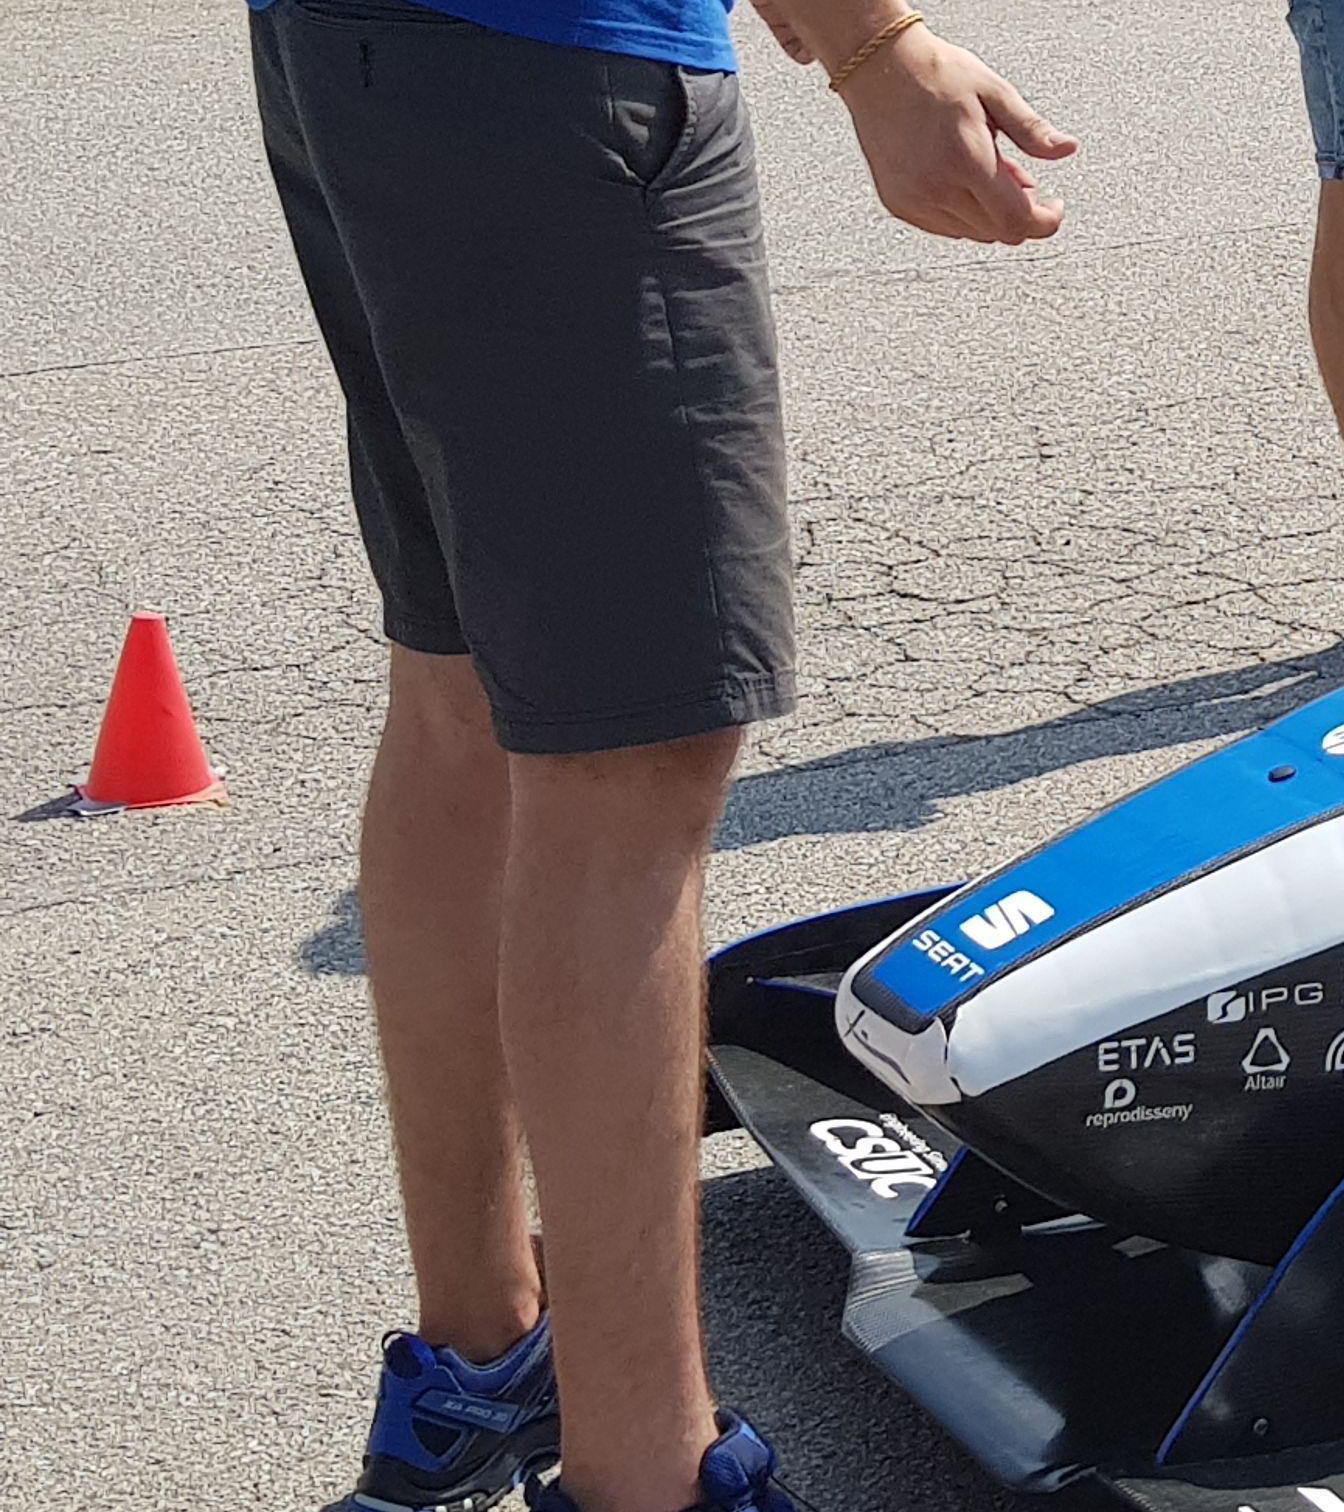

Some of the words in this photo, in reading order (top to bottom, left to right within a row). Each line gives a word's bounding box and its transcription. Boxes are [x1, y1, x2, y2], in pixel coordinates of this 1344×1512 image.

[912, 929, 985, 983] SEAT
[1249, 982, 1324, 1014] IPG
[1098, 1033, 1196, 1072] ETAS
[1244, 1073, 1288, 1092] Altair
[1086, 1104, 1194, 1129] reprodisseny
